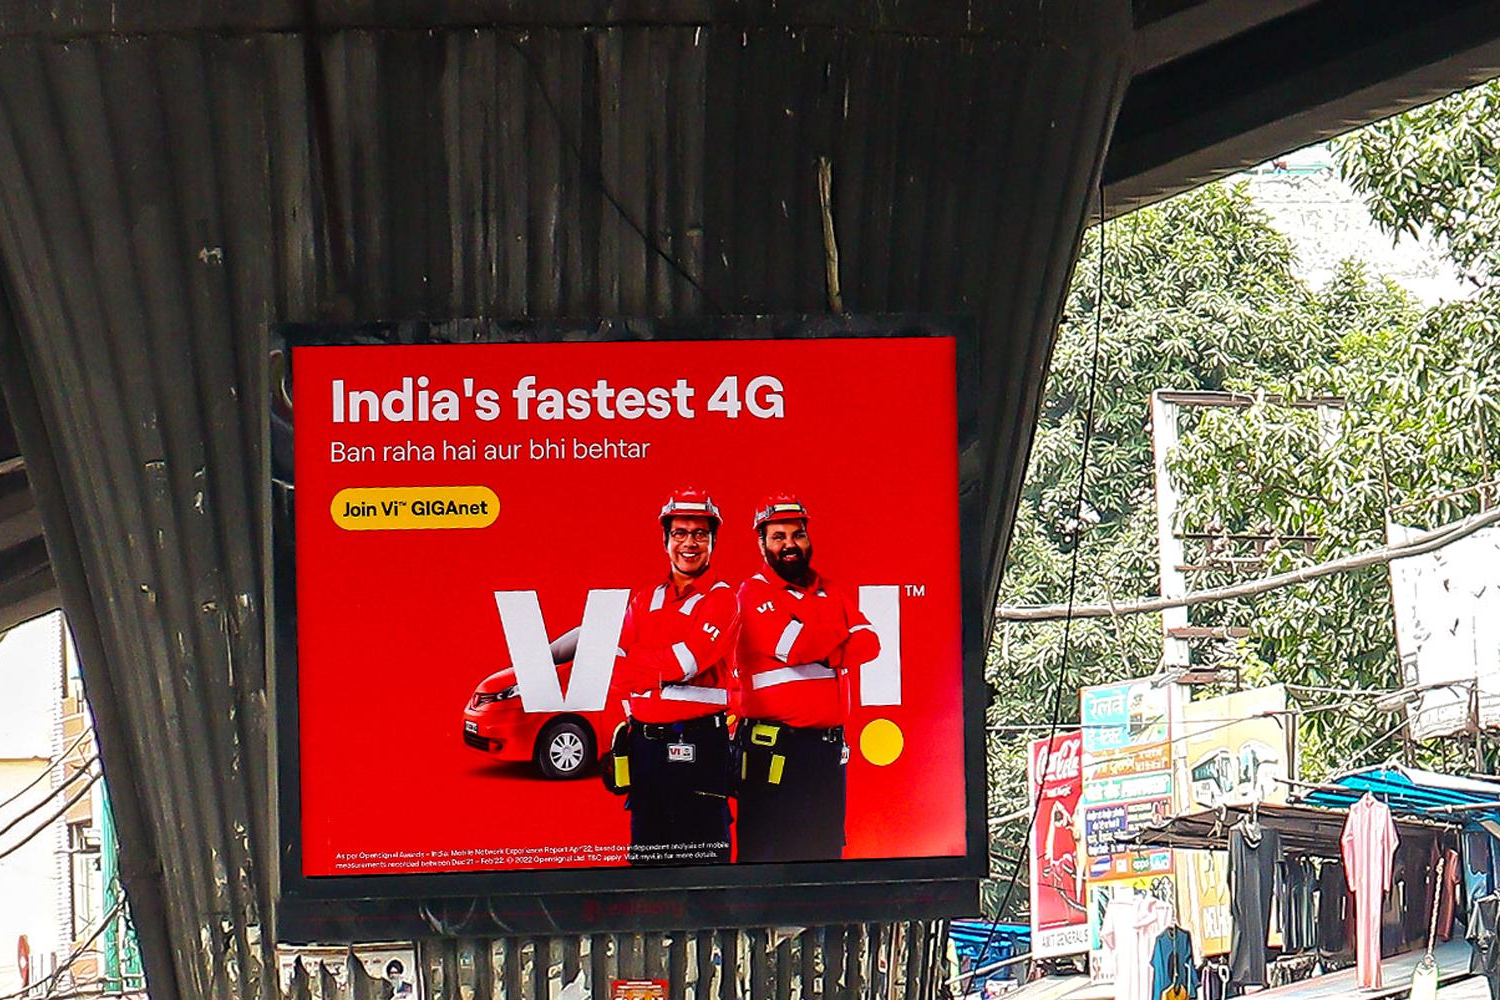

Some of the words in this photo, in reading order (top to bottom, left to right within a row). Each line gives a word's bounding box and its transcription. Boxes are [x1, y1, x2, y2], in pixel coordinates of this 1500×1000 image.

[332, 377, 501, 423] India's
[512, 376, 695, 420] fastest
[707, 375, 786, 419] 4G
[330, 441, 375, 463] Ban
[383, 440, 435, 462] raha
[443, 440, 477, 461] hai
[484, 443, 522, 460] aur
[529, 439, 566, 459] bhi
[573, 438, 651, 460] behtar
[343, 502, 377, 519] Join
[411, 500, 488, 518] GIGAnet
